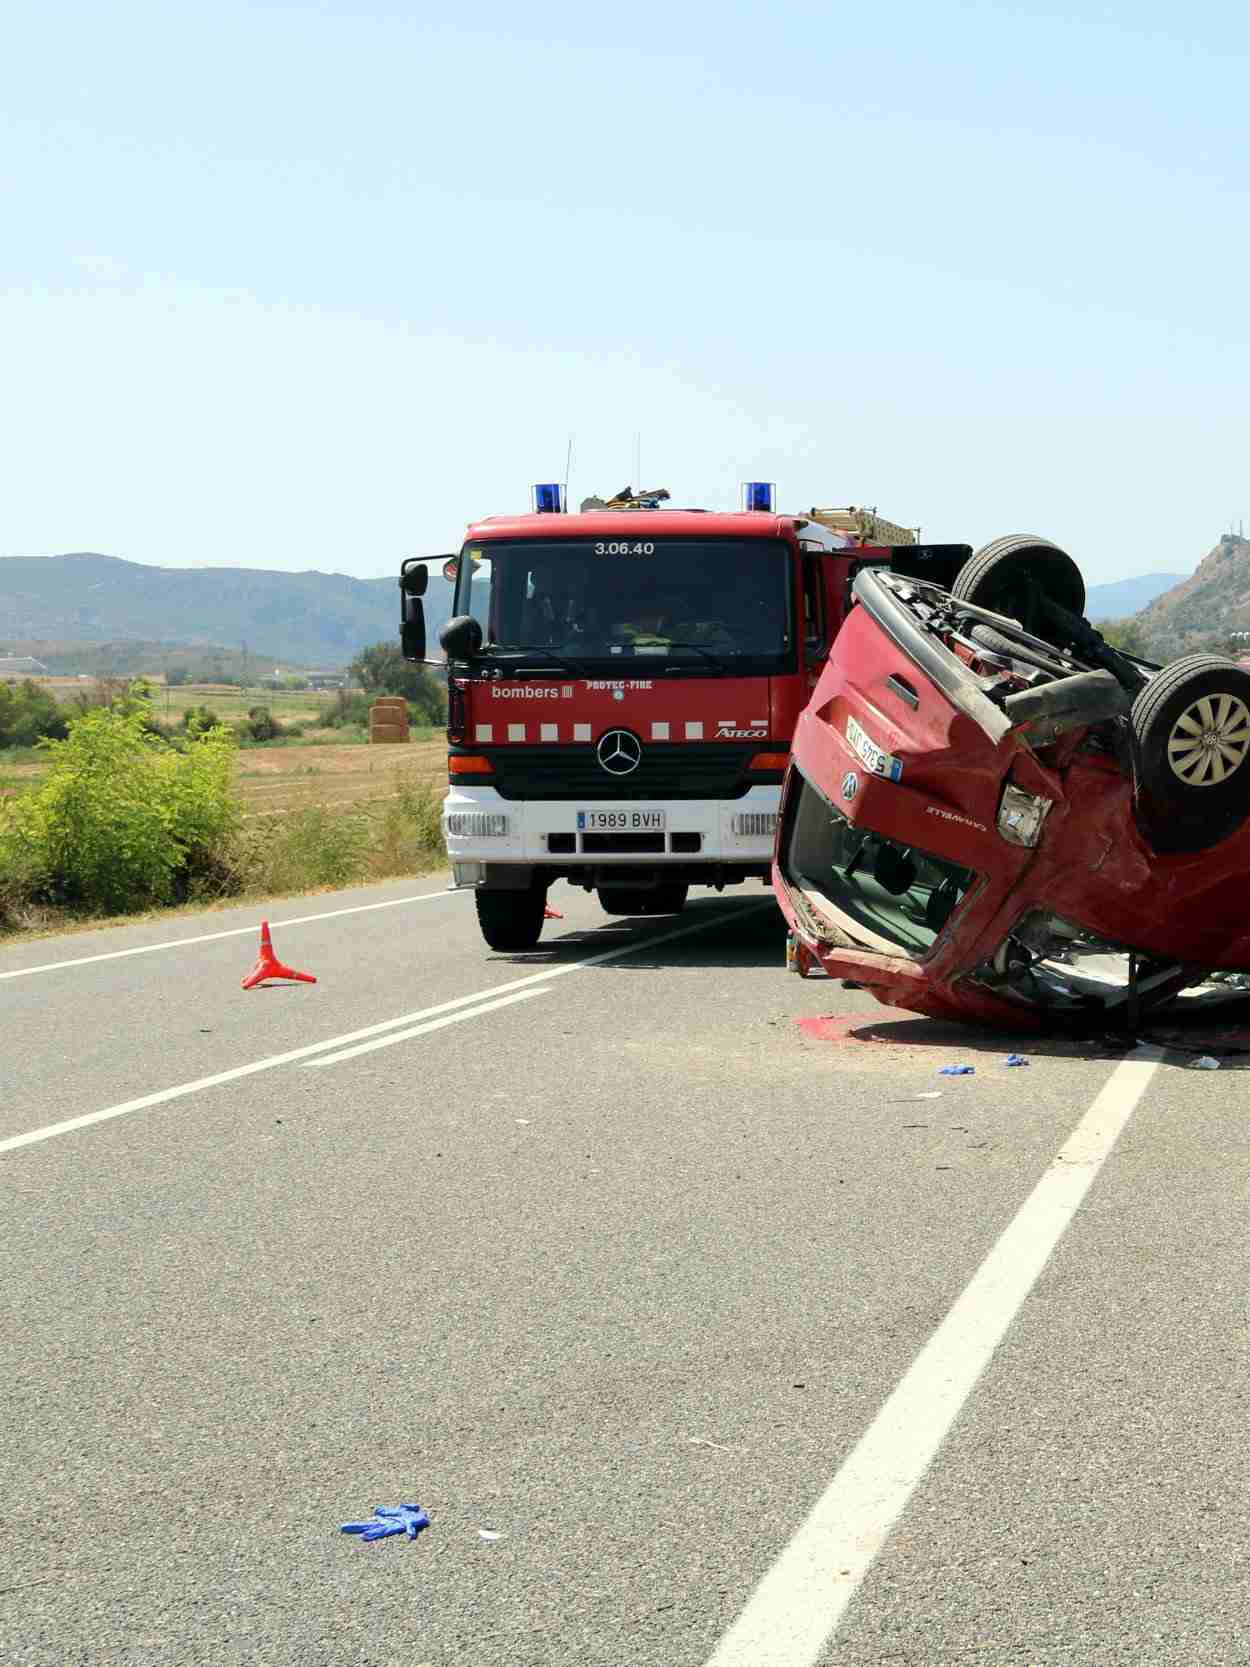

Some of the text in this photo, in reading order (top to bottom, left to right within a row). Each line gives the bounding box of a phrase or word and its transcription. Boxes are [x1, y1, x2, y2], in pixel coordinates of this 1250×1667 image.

[595, 542, 655, 555] 3.06.40
[491, 685, 559, 699] bombers
[590, 812, 661, 828] 1989 BVH
